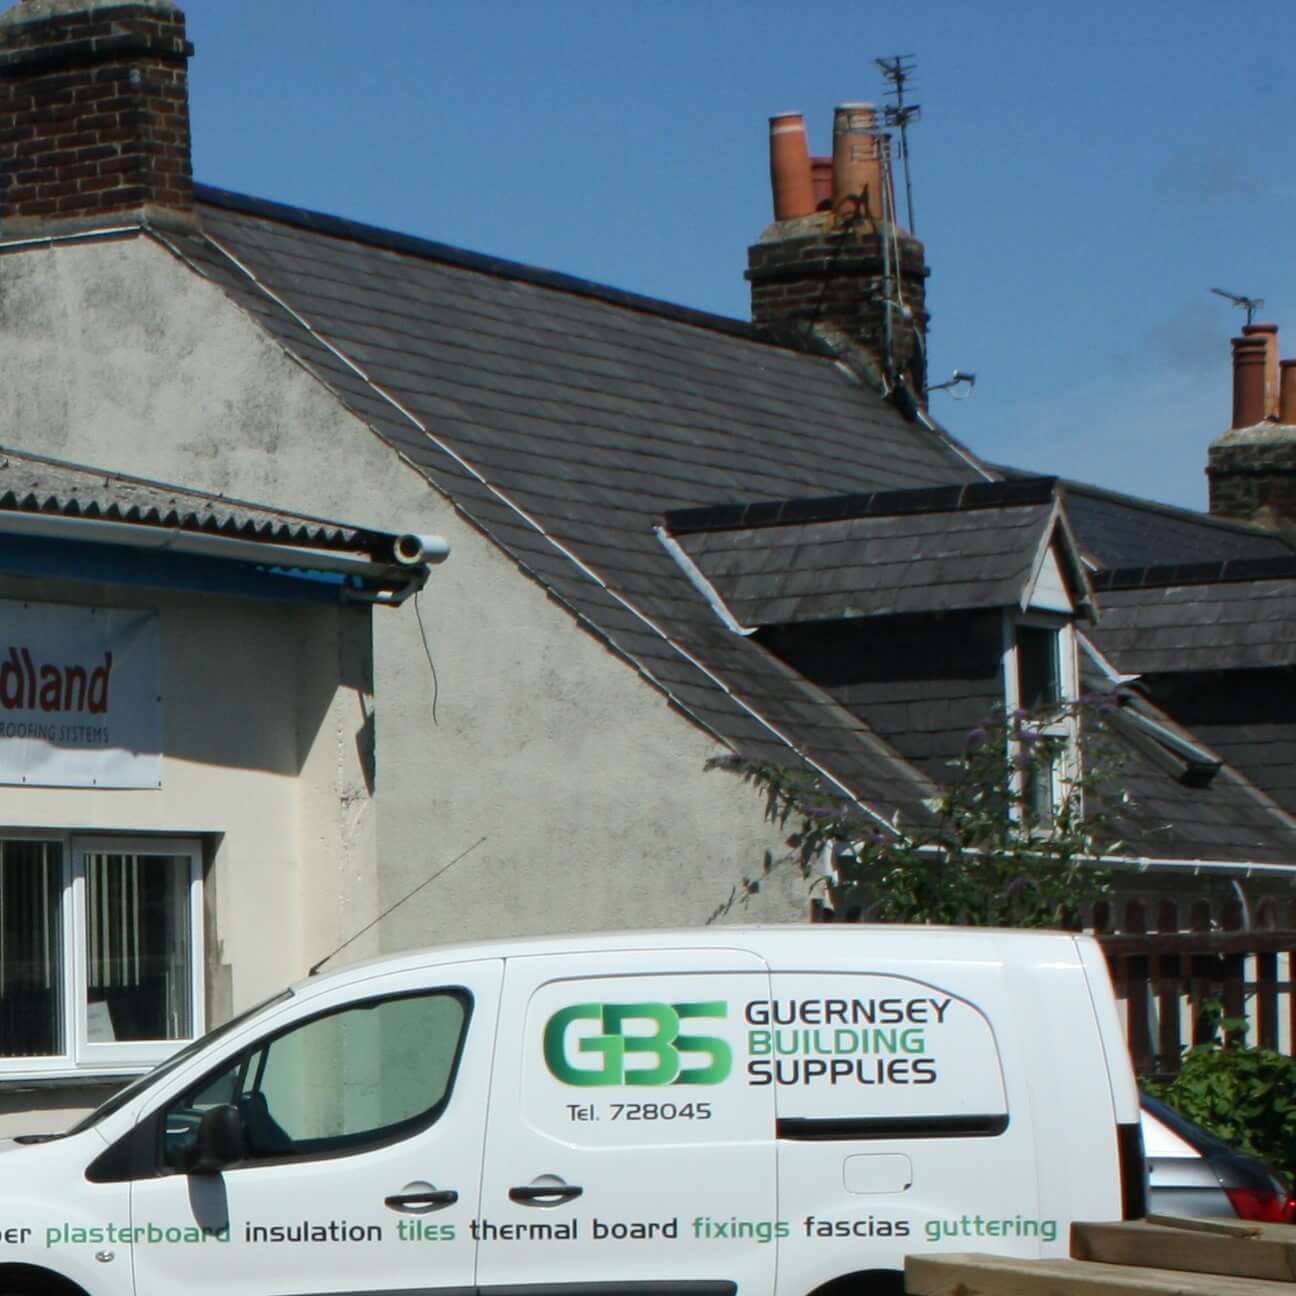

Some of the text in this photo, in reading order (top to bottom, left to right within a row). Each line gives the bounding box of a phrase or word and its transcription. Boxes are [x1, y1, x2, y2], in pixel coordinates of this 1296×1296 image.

[59, 724, 109, 744] SYSTEMS
[744, 999, 953, 1026] GUERNSEY
[542, 1000, 733, 1087] GBS
[747, 1027, 926, 1056] BUILDING
[746, 1057, 938, 1086] SUPPLIES
[566, 1102, 712, 1122] Tel. 728045
[45, 1220, 231, 1248] plasterboard
[245, 1220, 383, 1243] insulation
[396, 1219, 456, 1242] tiles
[469, 1217, 578, 1241] thermal
[592, 1217, 678, 1241] board
[691, 1214, 790, 1244] fixings
[803, 1214, 911, 1238] fascias
[924, 1213, 1058, 1244] guttering
